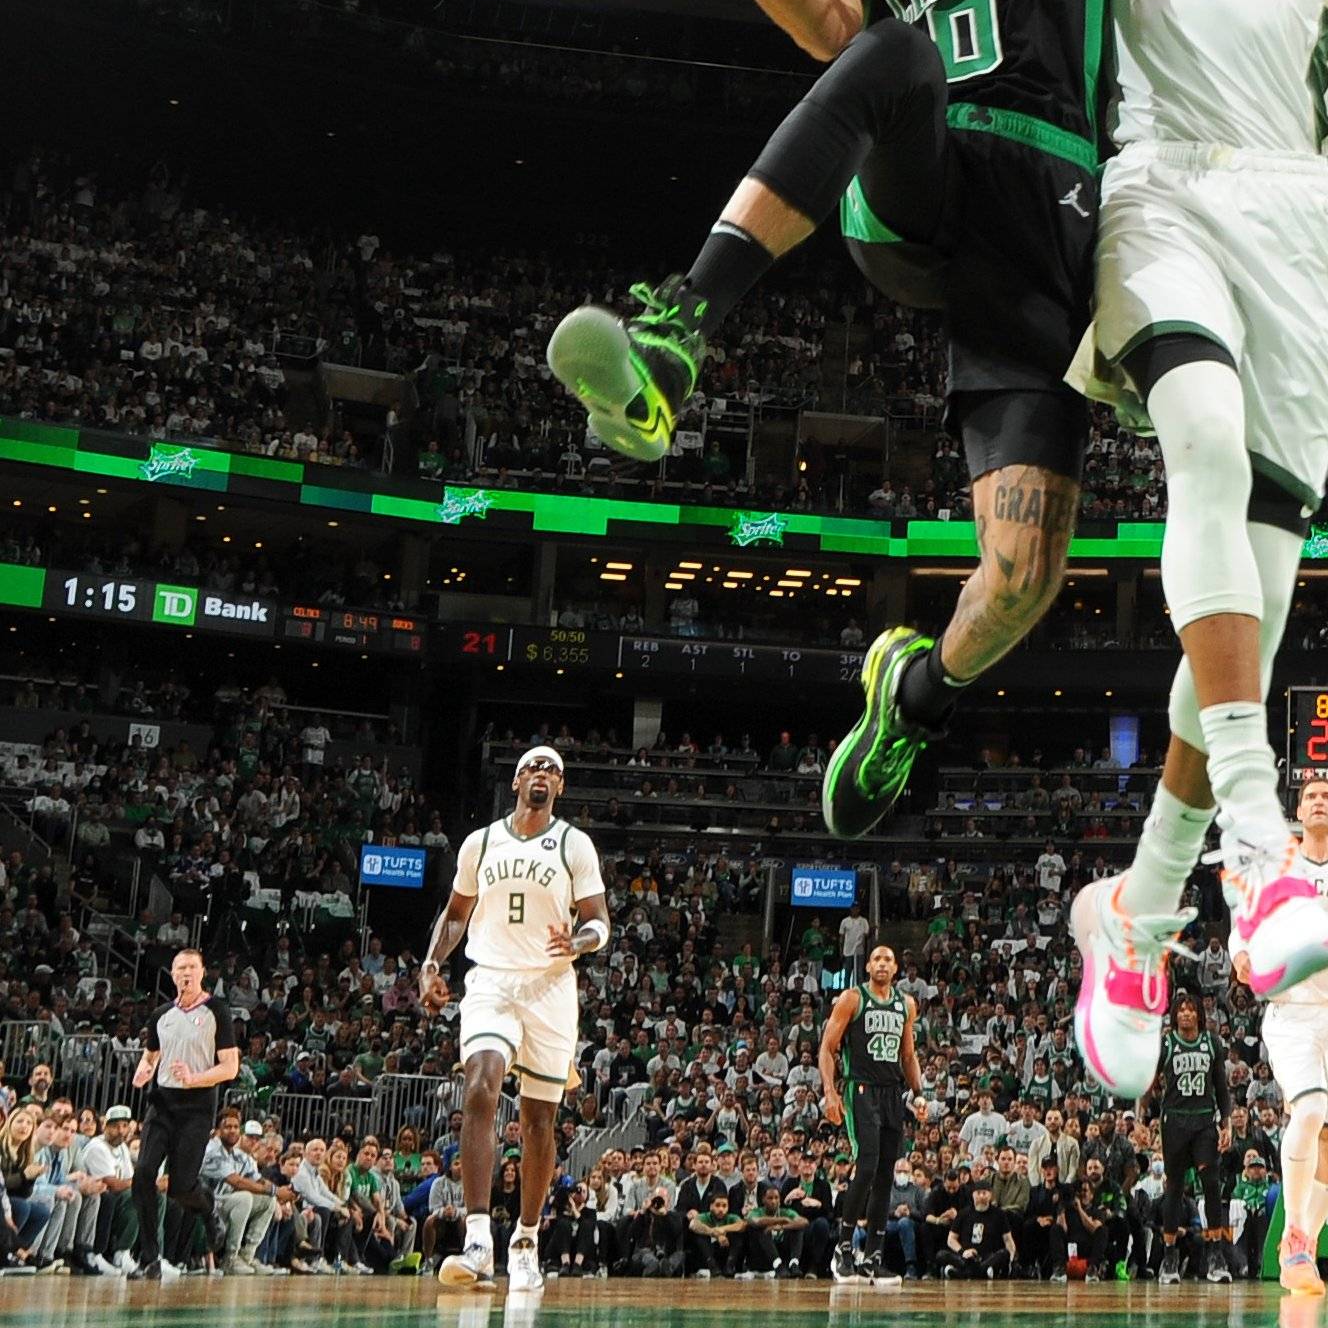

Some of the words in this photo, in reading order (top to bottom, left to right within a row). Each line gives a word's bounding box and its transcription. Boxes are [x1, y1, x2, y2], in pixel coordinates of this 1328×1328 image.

[63, 576, 137, 614] 1:15
[159, 590, 196, 619] TD
[204, 595, 268, 624] Bank
[462, 631, 497, 653] 21
[633, 641, 660, 653] REB
[681, 645, 708, 656] AST
[733, 648, 755, 659] STL
[782, 651, 801, 662] TO
[382, 856, 423, 871] TUFTS
[484, 859, 557, 889] BUCKS
[813, 878, 853, 891] TUFTS
[508, 892, 525, 924] 9
[864, 1009, 905, 1035] CELTICS
[867, 1034, 901, 1063] 42
[1172, 1052, 1211, 1074] CELTICS
[1176, 1072, 1206, 1096] 44
